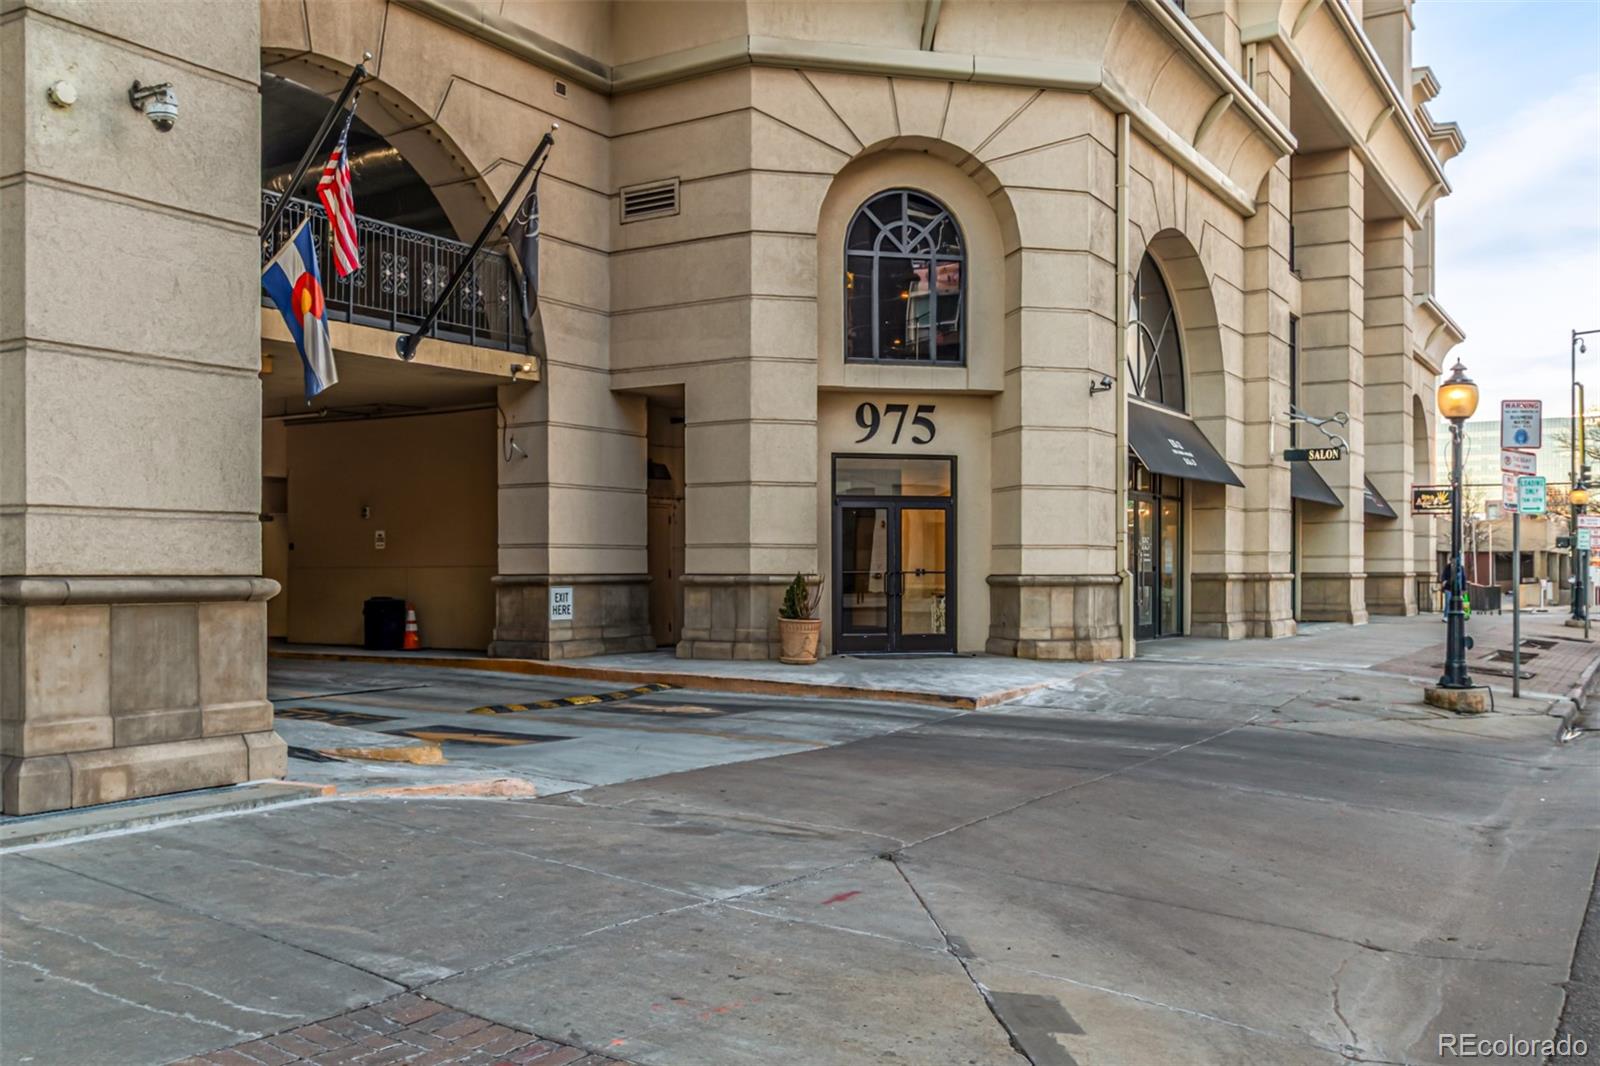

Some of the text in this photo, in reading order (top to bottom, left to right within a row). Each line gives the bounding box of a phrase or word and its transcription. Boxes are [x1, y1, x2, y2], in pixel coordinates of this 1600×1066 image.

[855, 402, 936, 445] 975
[1308, 449, 1339, 460] SALON
[554, 592, 569, 603] EXIT
[552, 604, 571, 615] HERE
